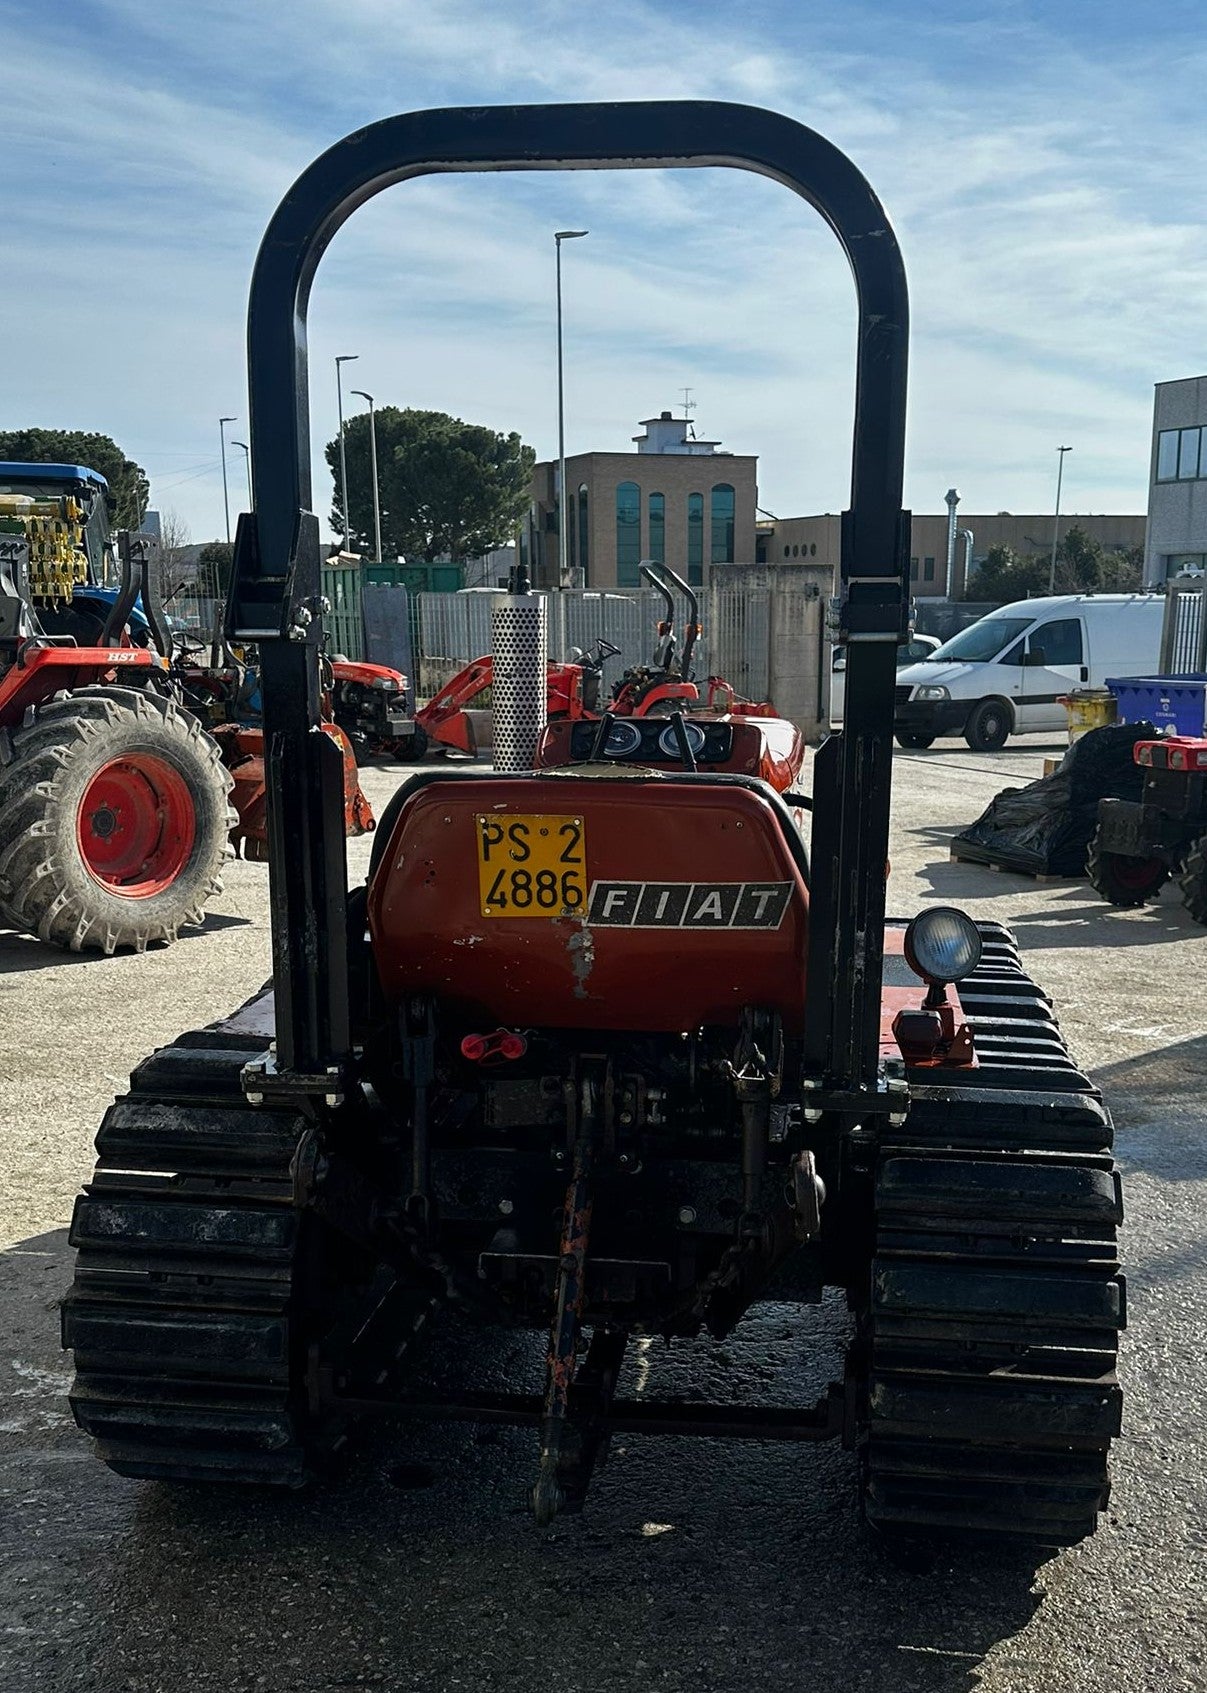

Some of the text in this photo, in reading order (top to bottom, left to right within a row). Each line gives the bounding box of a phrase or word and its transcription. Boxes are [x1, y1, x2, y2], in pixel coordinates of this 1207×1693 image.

[107, 652, 138, 662] HST
[482, 823, 582, 863] PS 2
[485, 869, 583, 909] 4886
[602, 890, 779, 920] FIAT
